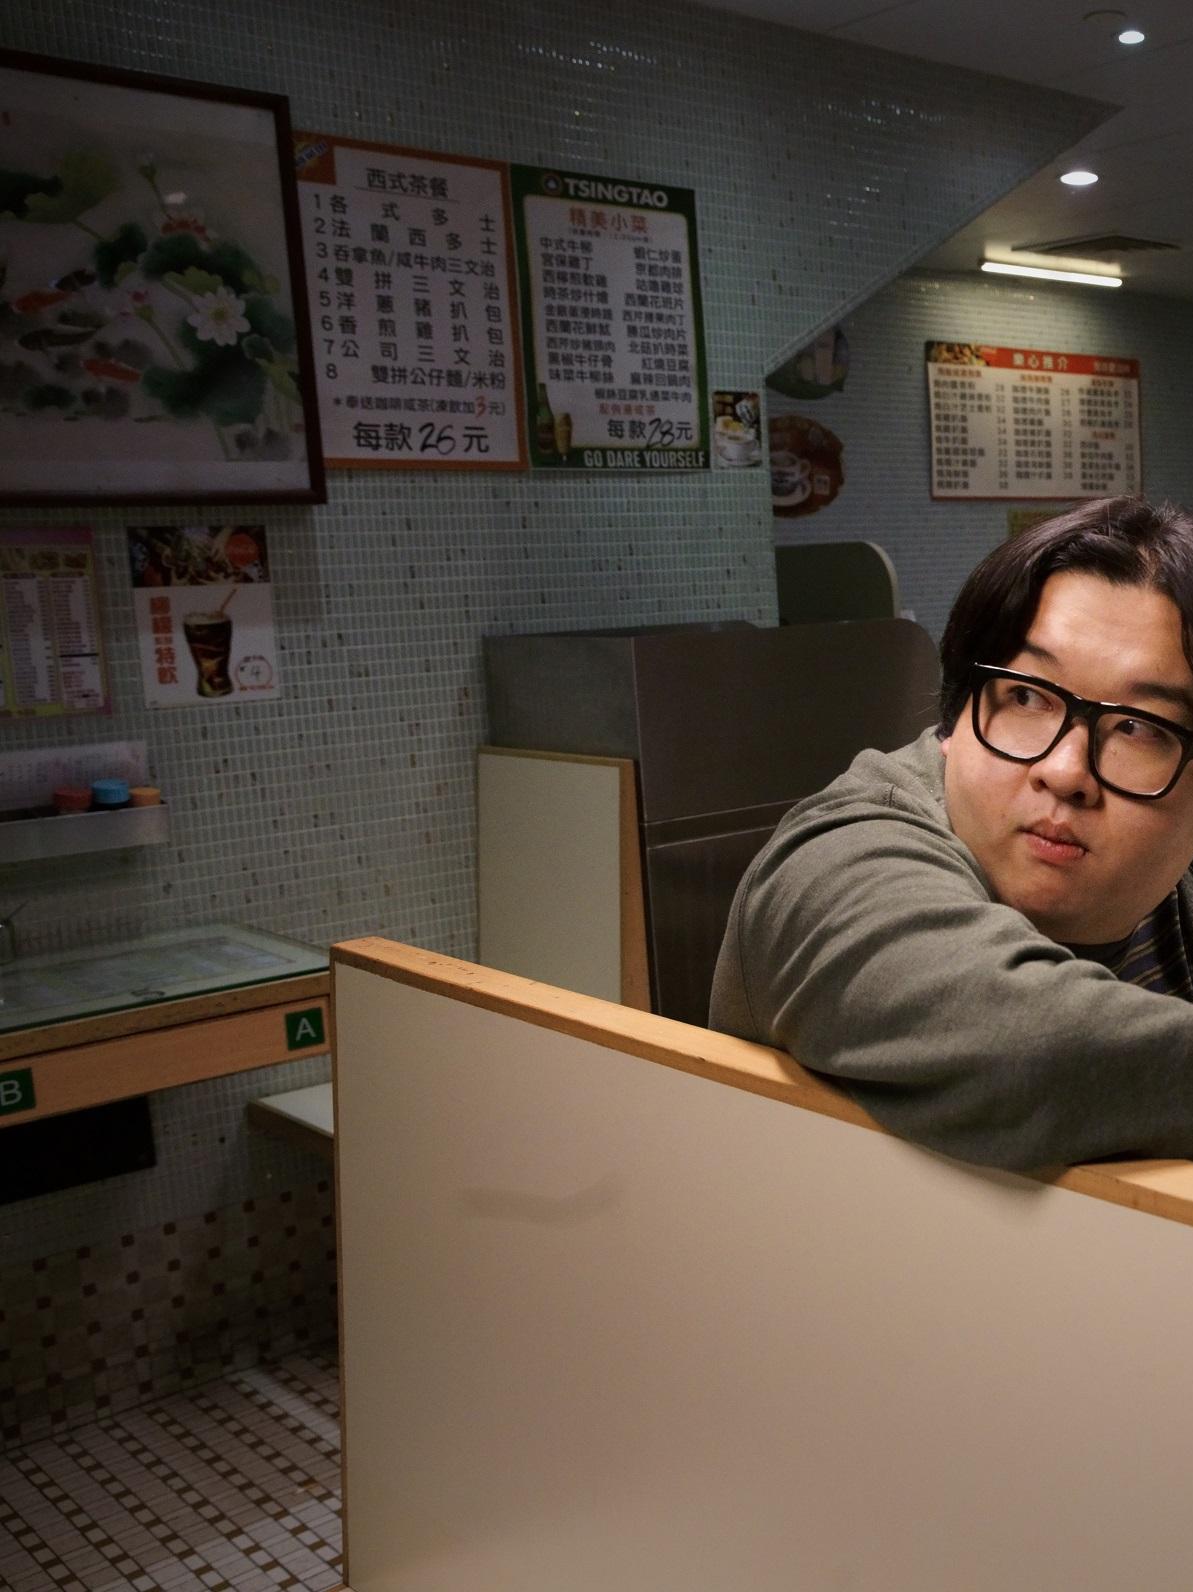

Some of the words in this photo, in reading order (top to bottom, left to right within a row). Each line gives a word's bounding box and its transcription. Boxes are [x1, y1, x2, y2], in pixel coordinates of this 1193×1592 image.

[366, 167, 449, 198] 西式茶餐
[564, 178, 668, 207] TSINGTAO
[313, 194, 321, 209] 1
[330, 194, 496, 232] 各式多士
[314, 218, 326, 234] 2
[331, 219, 498, 255] 法蘭西多士
[316, 243, 328, 258] 3
[319, 267, 329, 282] 4
[335, 267, 500, 301] 雙拼三文治
[320, 291, 331, 307] 5
[321, 315, 333, 331] 6
[324, 339, 335, 355] 7
[340, 339, 505, 368] 公司三文治
[326, 363, 338, 380] 8
[584, 450, 603, 468] GO
[607, 450, 640, 468] DARE
[644, 450, 706, 468] YOURSELF
[295, 1017, 317, 1041] A
[0, 1079, 23, 1106] B
